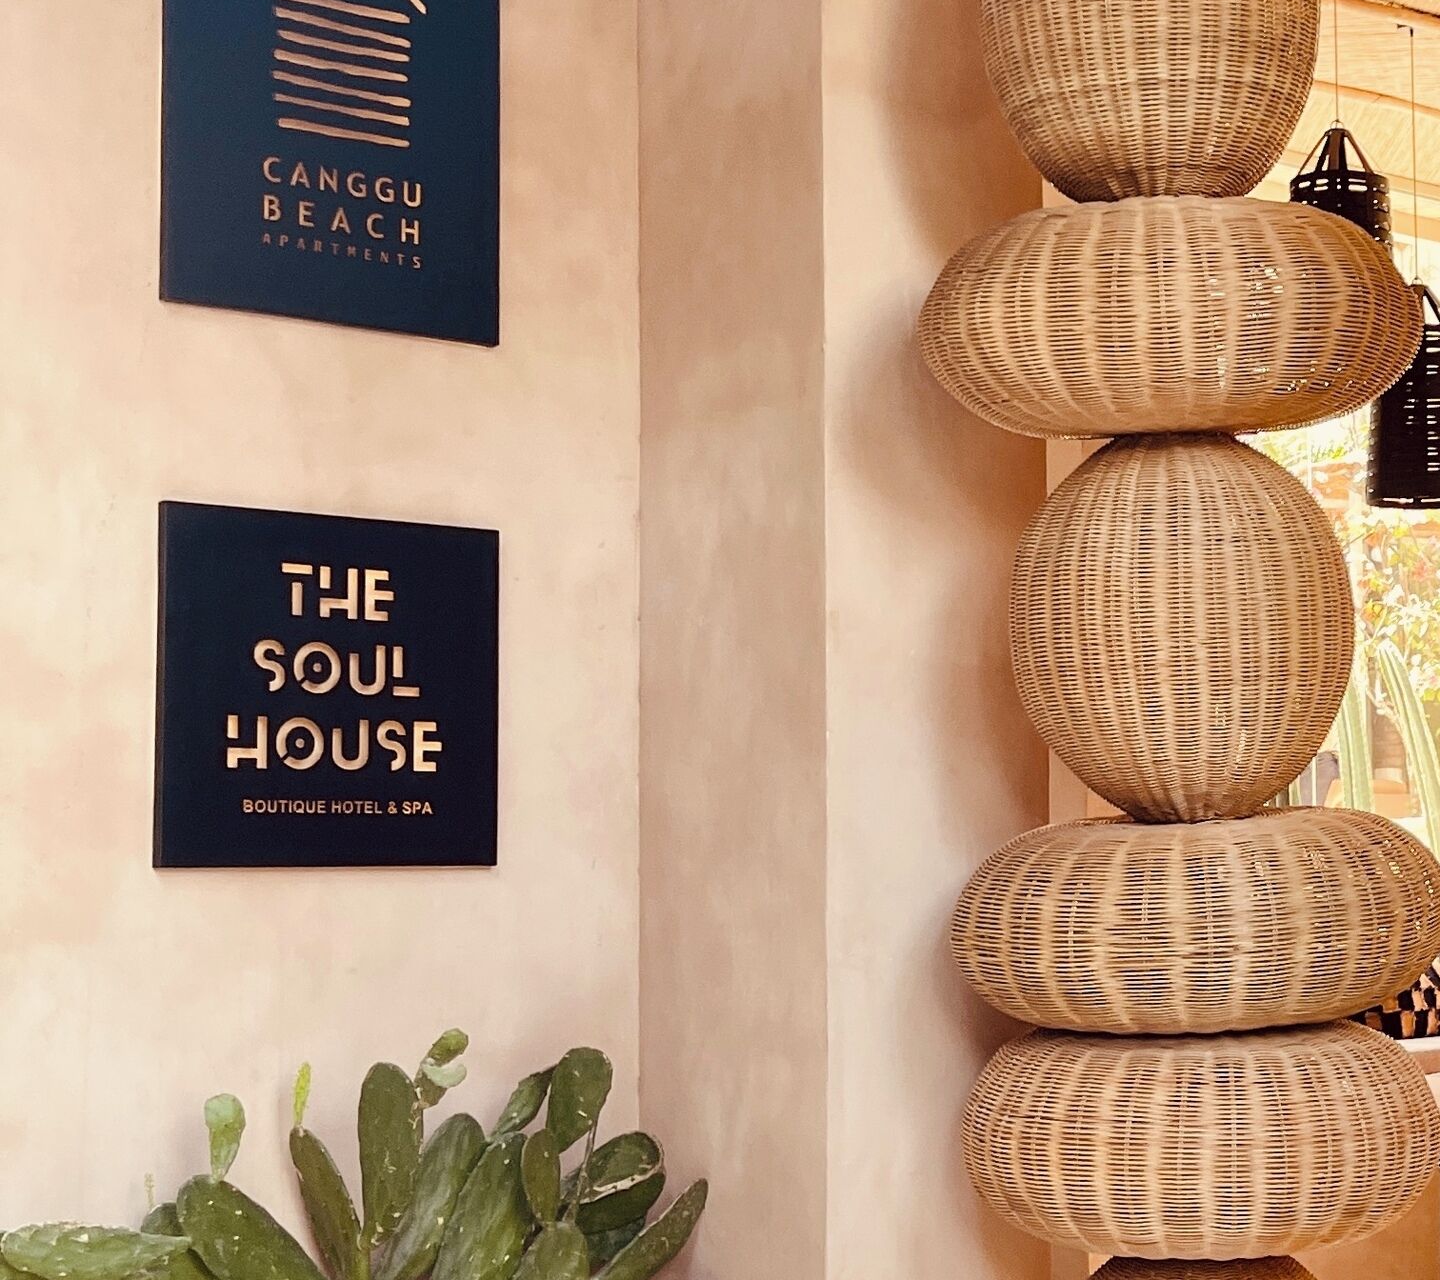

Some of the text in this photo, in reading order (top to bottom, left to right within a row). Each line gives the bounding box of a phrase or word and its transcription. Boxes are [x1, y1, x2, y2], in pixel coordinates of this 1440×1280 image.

[263, 157, 422, 208] CANGGU
[263, 195, 420, 245] BEACH
[263, 233, 422, 269] APARTMENTS
[281, 562, 394, 622] THE
[253, 639, 420, 697] SOUL
[226, 714, 443, 772] HOUSE
[242, 799, 433, 815] BOUTIQUE HOTEL & SPA
